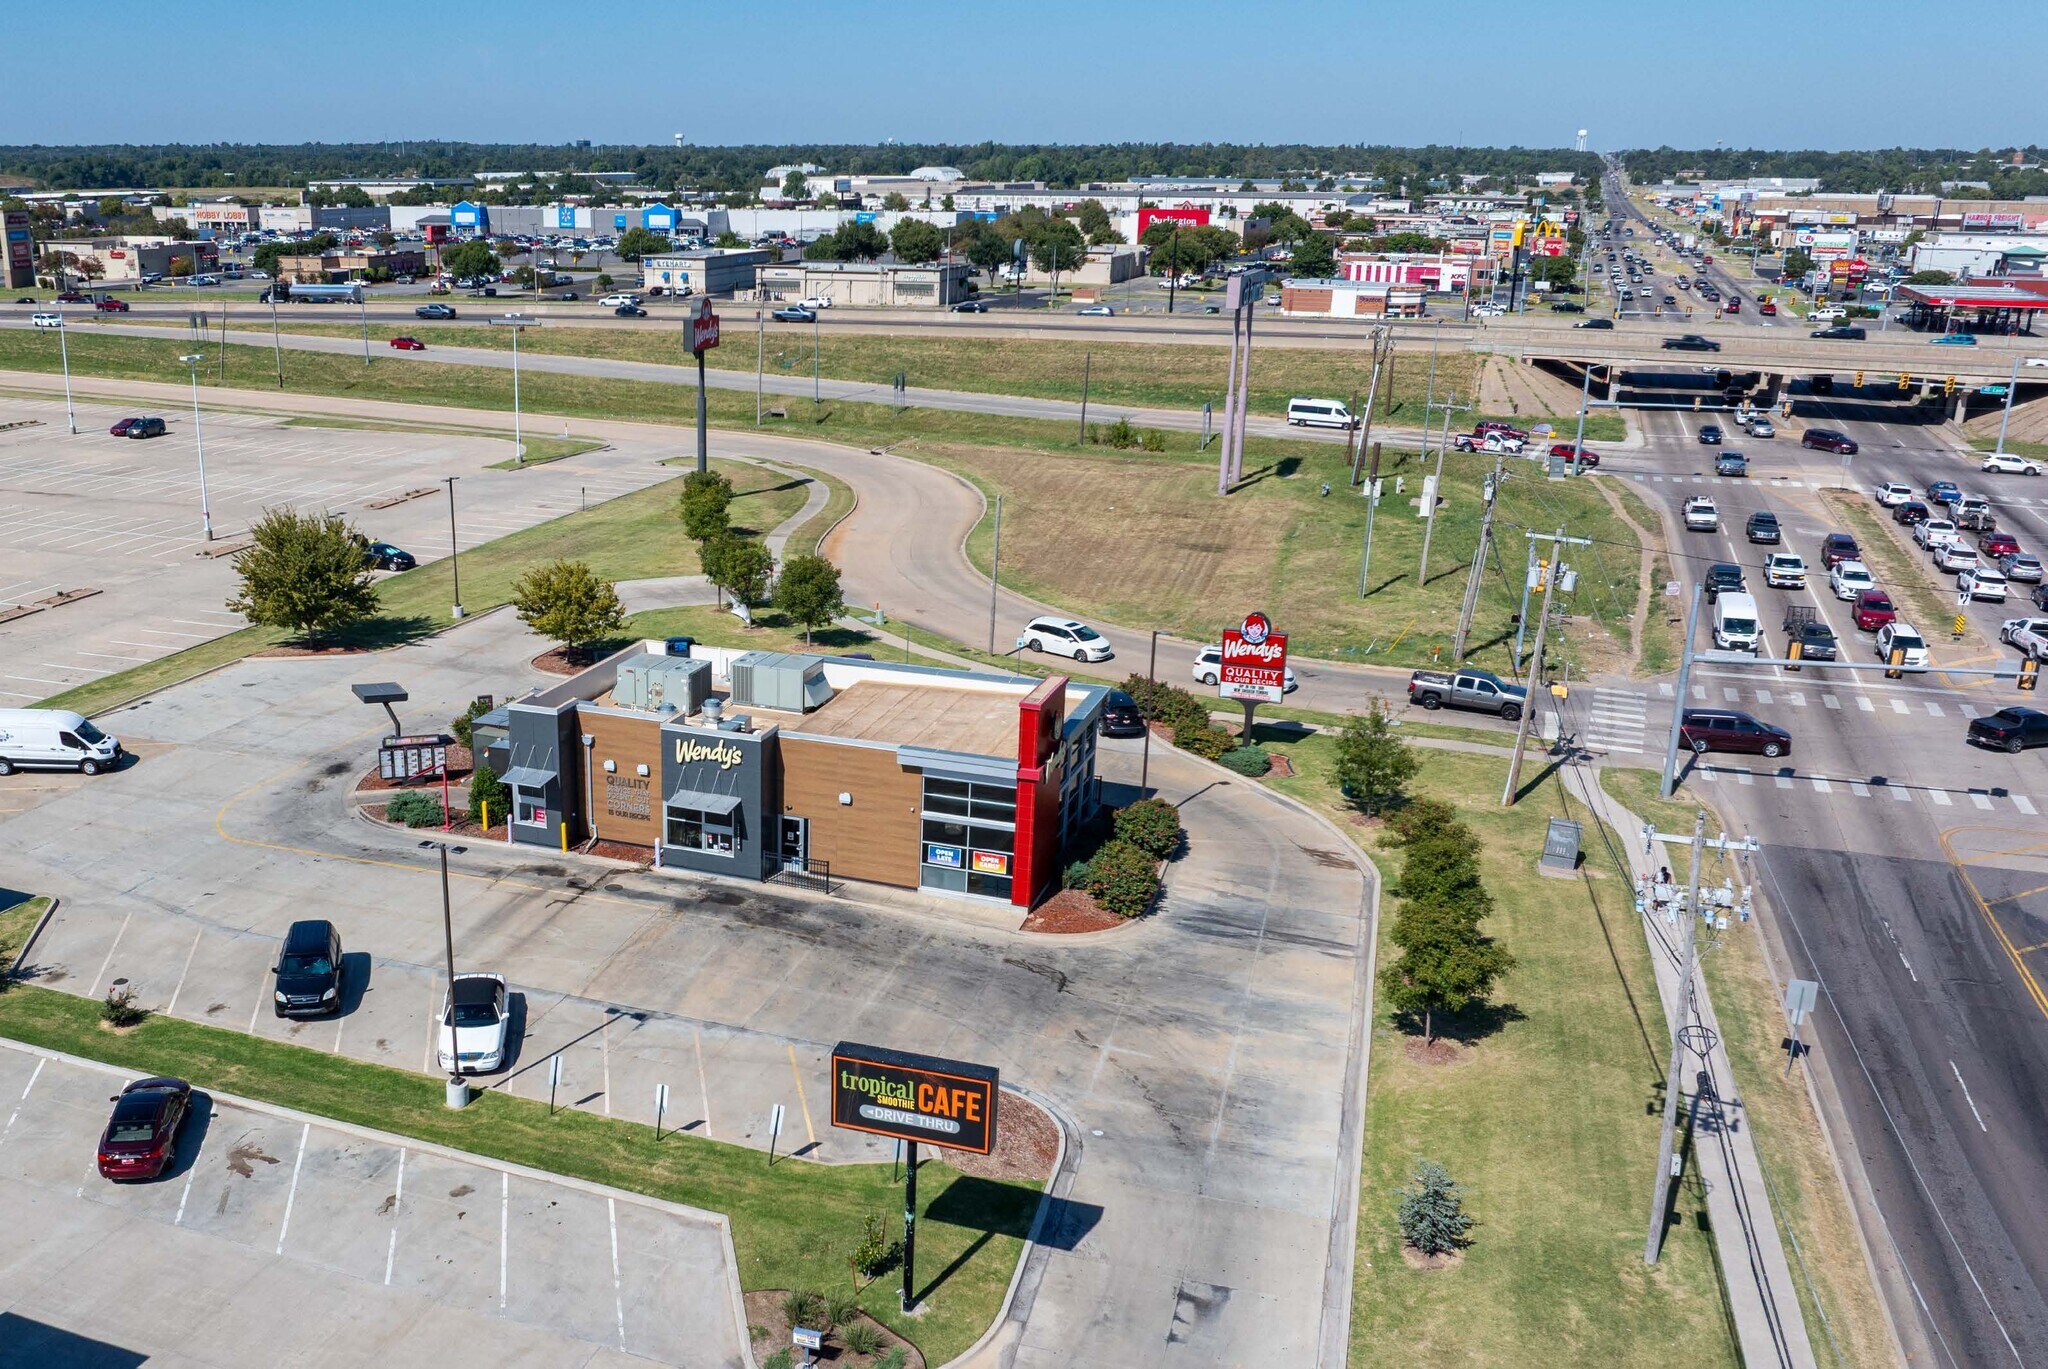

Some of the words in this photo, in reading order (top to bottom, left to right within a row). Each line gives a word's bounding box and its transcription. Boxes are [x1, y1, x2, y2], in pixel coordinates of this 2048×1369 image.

[196, 211, 220, 219] HOBBY
[223, 211, 247, 220] LOBBY
[1994, 214, 2020, 222] FREIGHT
[695, 320, 718, 347] Wendy's
[1225, 639, 1283, 662] Wendy's
[1226, 667, 1279, 681] QUALITY
[1252, 678, 1278, 686] RECIPE
[676, 738, 742, 769] Wendy's
[606, 775, 650, 791] QUALITY
[607, 799, 651, 814] CORNERS
[615, 810, 628, 818] OUR
[629, 812, 651, 822] RECIPE
[936, 849, 953, 857] OPEN
[981, 856, 999, 864] OPEN
[841, 1070, 915, 1101] tropical
[877, 1094, 915, 1111] SMOOTHIE
[918, 1083, 982, 1123] CAFE
[875, 1107, 914, 1123] DRIVE
[918, 1114, 954, 1131] THRU
